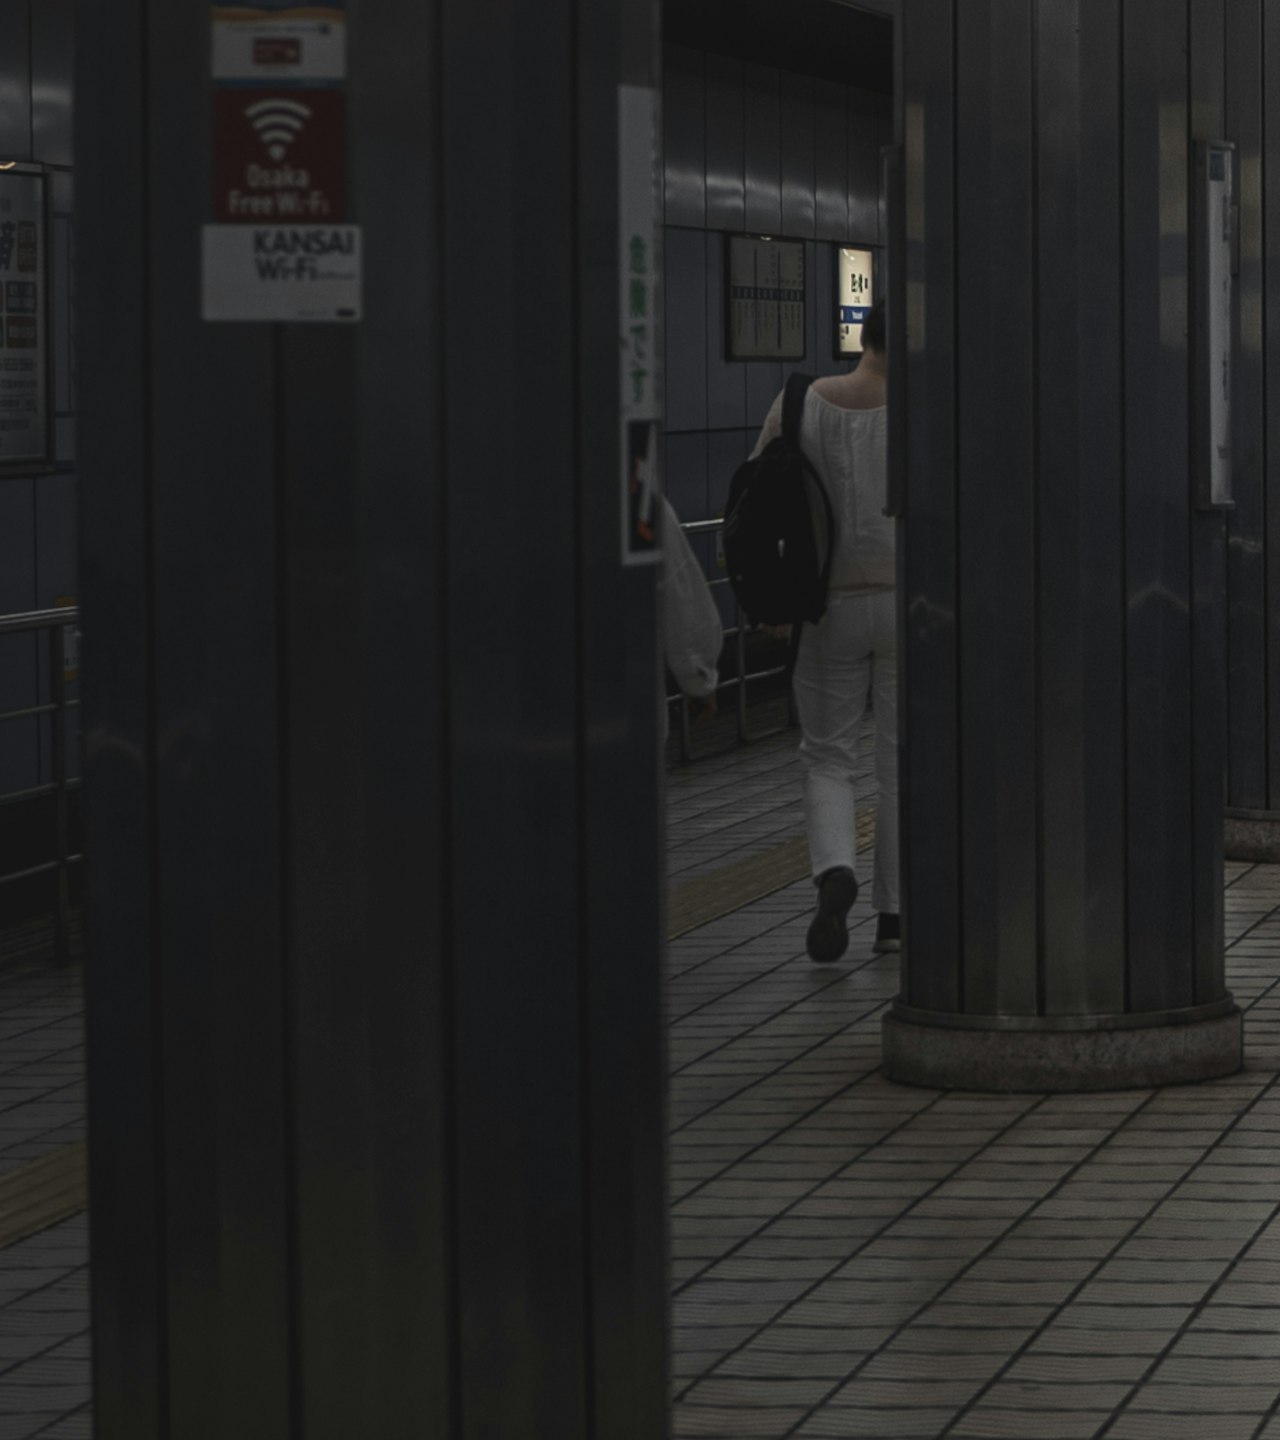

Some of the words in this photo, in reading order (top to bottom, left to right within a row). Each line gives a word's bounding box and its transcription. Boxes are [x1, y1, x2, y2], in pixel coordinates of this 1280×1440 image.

[246, 163, 310, 189] Osaka
[227, 189, 273, 215] Free
[254, 229, 354, 255] KANSAI
[255, 256, 319, 280] Wi-Fi
